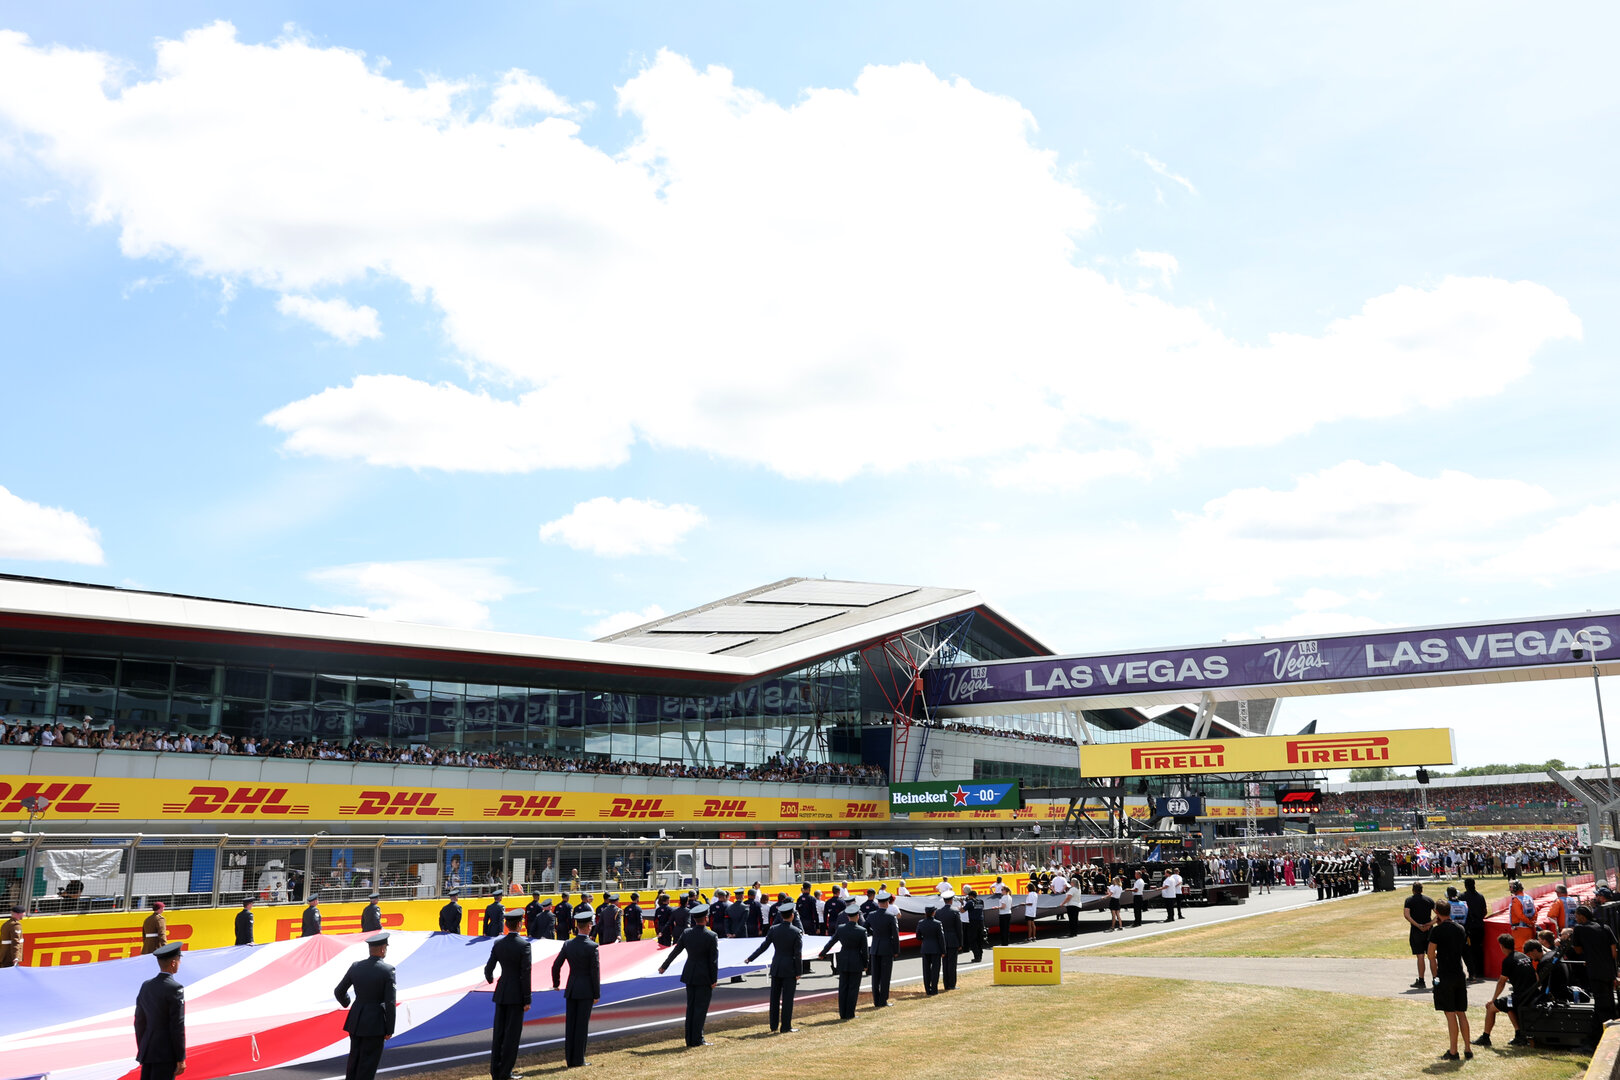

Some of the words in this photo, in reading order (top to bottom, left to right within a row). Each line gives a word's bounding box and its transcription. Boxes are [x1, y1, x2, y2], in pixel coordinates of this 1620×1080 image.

[1299, 641, 1318, 654] LAS
[1366, 638, 1449, 669] LAS
[1456, 625, 1612, 660] VEGAS
[1263, 644, 1329, 680] Vegas
[971, 668, 987, 678] LAS
[1025, 666, 1094, 692] LAS
[1100, 656, 1229, 686] VEGAS
[944, 669, 993, 701] Vegas
[1131, 745, 1225, 770] PIRELLI
[1286, 737, 1389, 764] PIRELLI
[183, 786, 292, 814] DHL
[355, 791, 440, 815] DHL
[497, 795, 565, 816] DHL
[892, 791, 948, 804] Heineken
[1168, 800, 1188, 813] FIA
[1281, 792, 1316, 802] F1
[610, 798, 665, 818] DHL
[702, 799, 749, 817] DHL
[845, 803, 881, 818] DHL
[1000, 959, 1053, 973] PIRELLI
